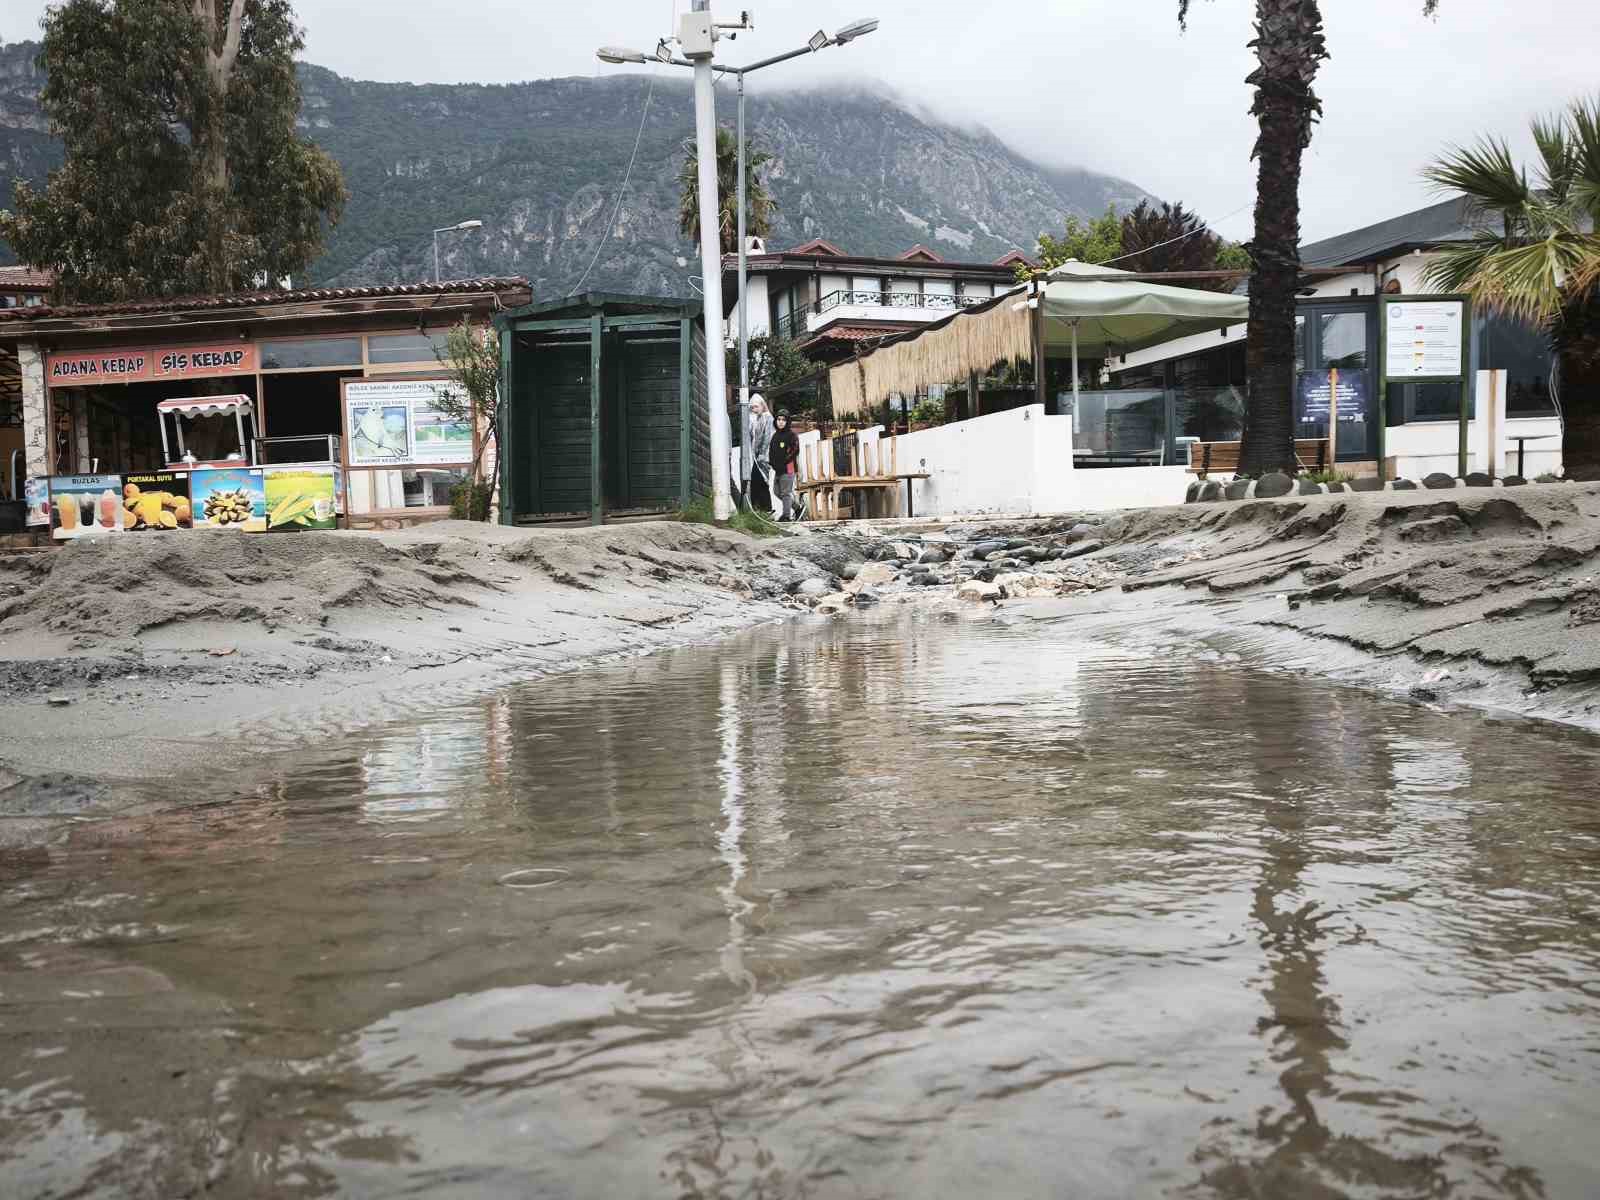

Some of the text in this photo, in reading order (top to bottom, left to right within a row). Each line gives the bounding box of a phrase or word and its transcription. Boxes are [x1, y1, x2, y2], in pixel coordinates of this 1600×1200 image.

[53, 357, 144, 377] ADANA KEBAP
[161, 350, 244, 372] ŞİŞ KEBAP
